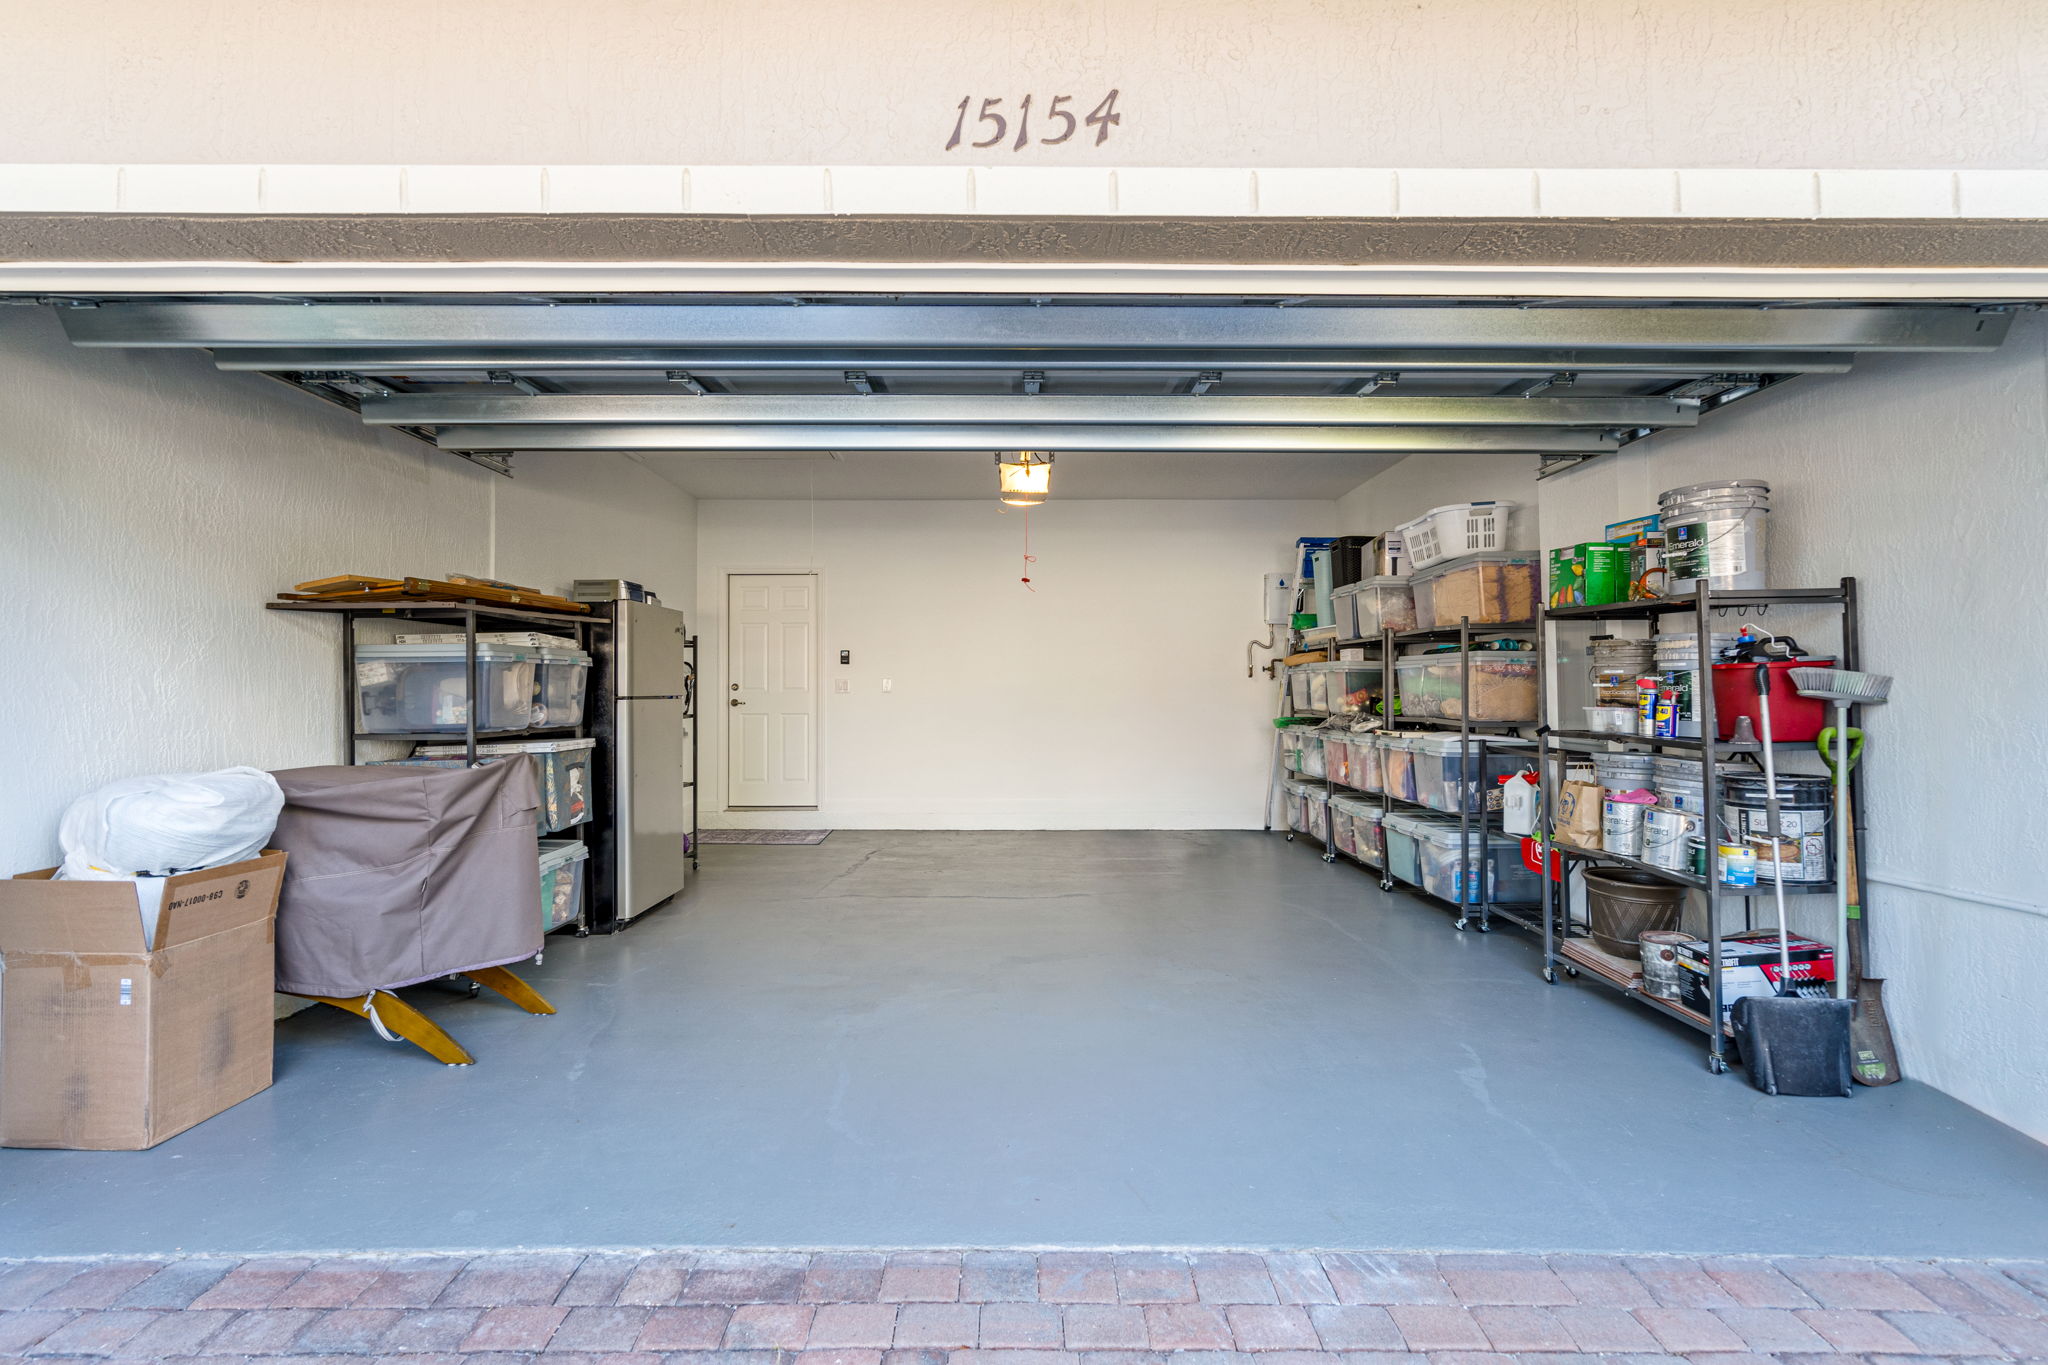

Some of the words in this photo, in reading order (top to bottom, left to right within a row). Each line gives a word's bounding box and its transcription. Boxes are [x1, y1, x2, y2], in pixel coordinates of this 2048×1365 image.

[945, 88, 1121, 152] 15154
[1668, 538, 1705, 552] Emerald
[1786, 820, 1798, 828] 20
